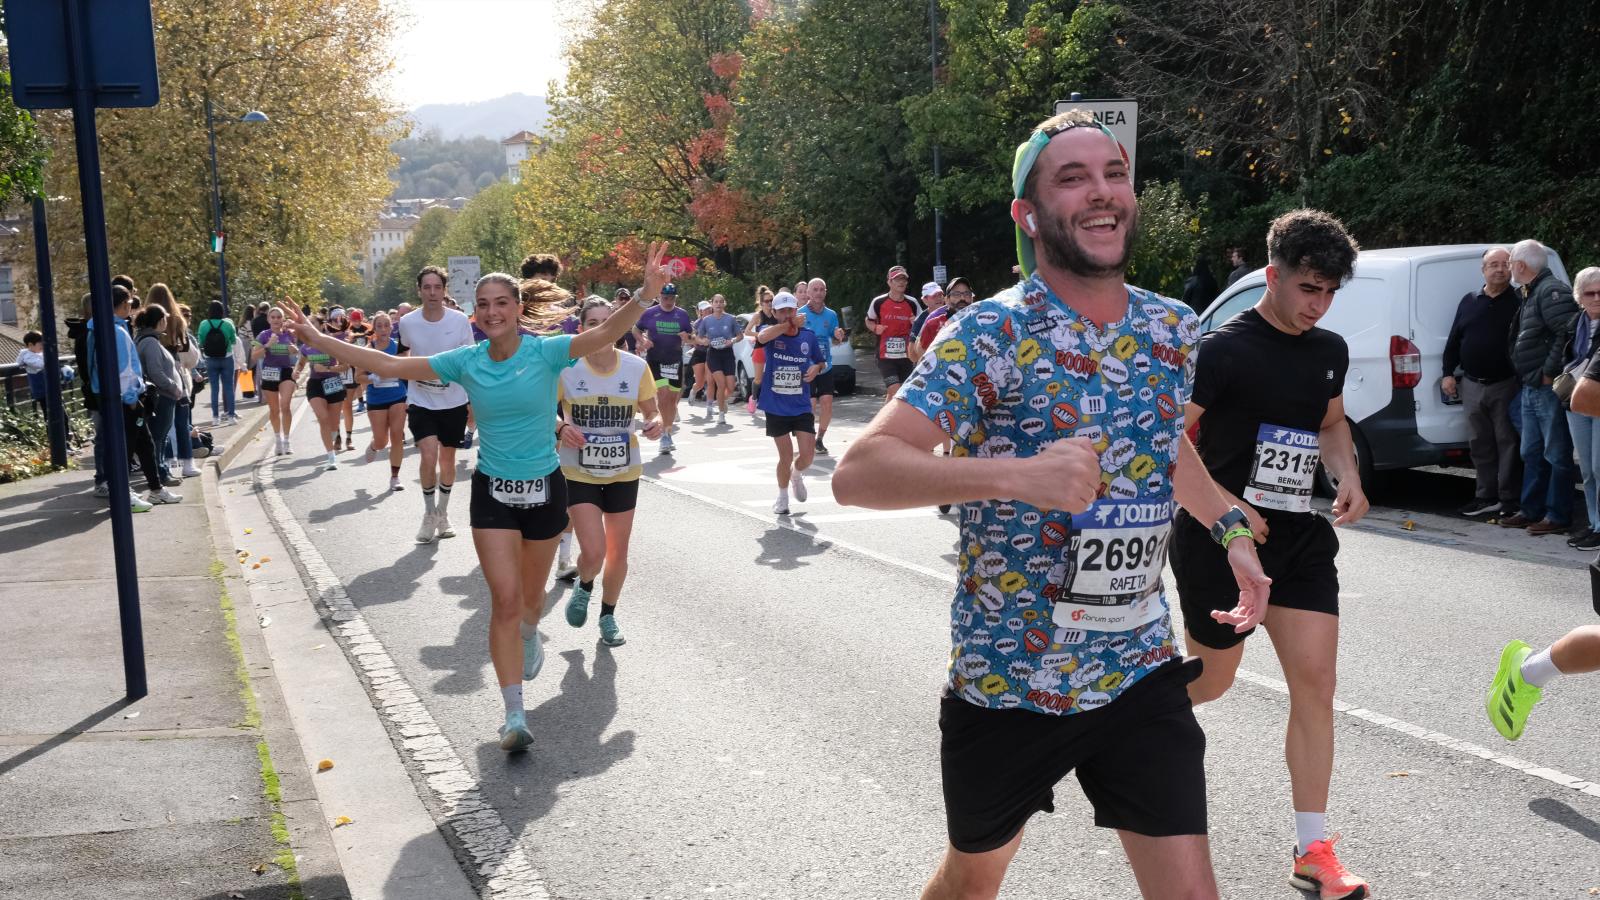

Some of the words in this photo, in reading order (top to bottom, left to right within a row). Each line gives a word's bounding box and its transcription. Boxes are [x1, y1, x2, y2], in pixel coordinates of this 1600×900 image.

[1152, 343, 1187, 368] BOOM
[1055, 350, 1098, 375] BOOM
[775, 372, 801, 381] 26736
[928, 393, 942, 404] HA!
[1140, 389, 1151, 398] HA!
[597, 396, 609, 405] 59
[571, 403, 633, 421] BEHOBIA
[584, 445, 626, 458] 17083
[1260, 447, 1319, 475] 23155
[494, 477, 544, 494] 26879
[1277, 476, 1303, 486] BERNA
[1109, 574, 1146, 591] RAFITA
[1107, 615, 1126, 624] sport
[1043, 657, 1070, 665] CRASH
[1027, 690, 1074, 712] BOOM
